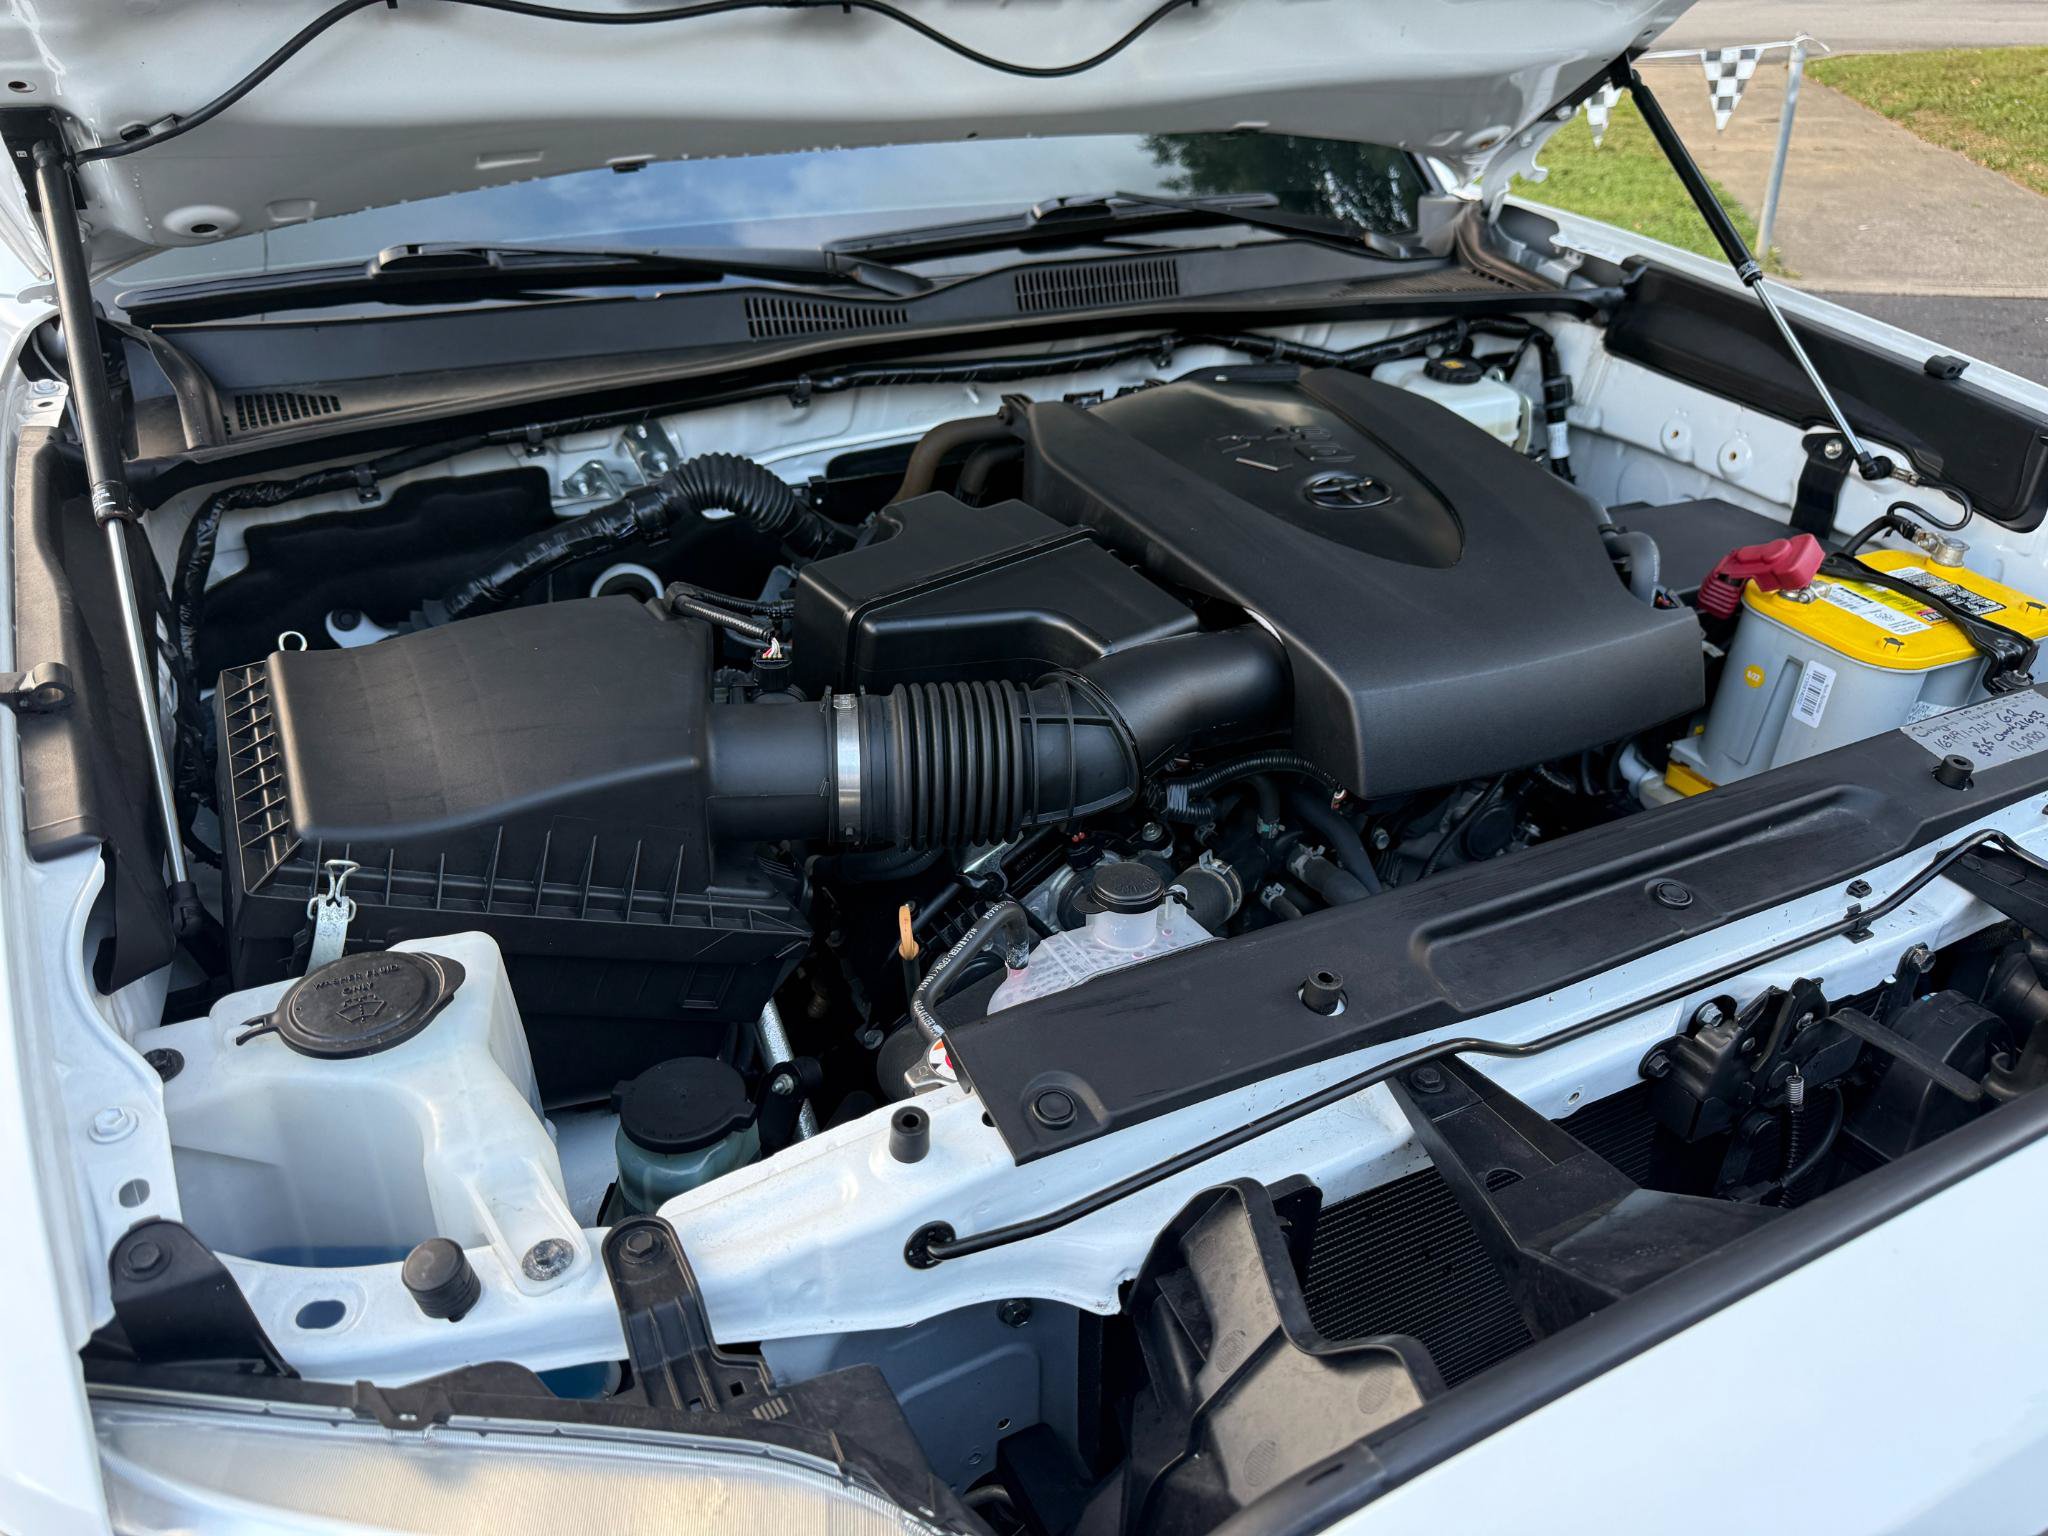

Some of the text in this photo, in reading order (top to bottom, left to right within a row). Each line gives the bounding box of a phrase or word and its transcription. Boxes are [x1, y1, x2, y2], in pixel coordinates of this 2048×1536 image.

[313, 963, 401, 991] WASHER FLUID
[342, 981, 374, 996] ONLY
